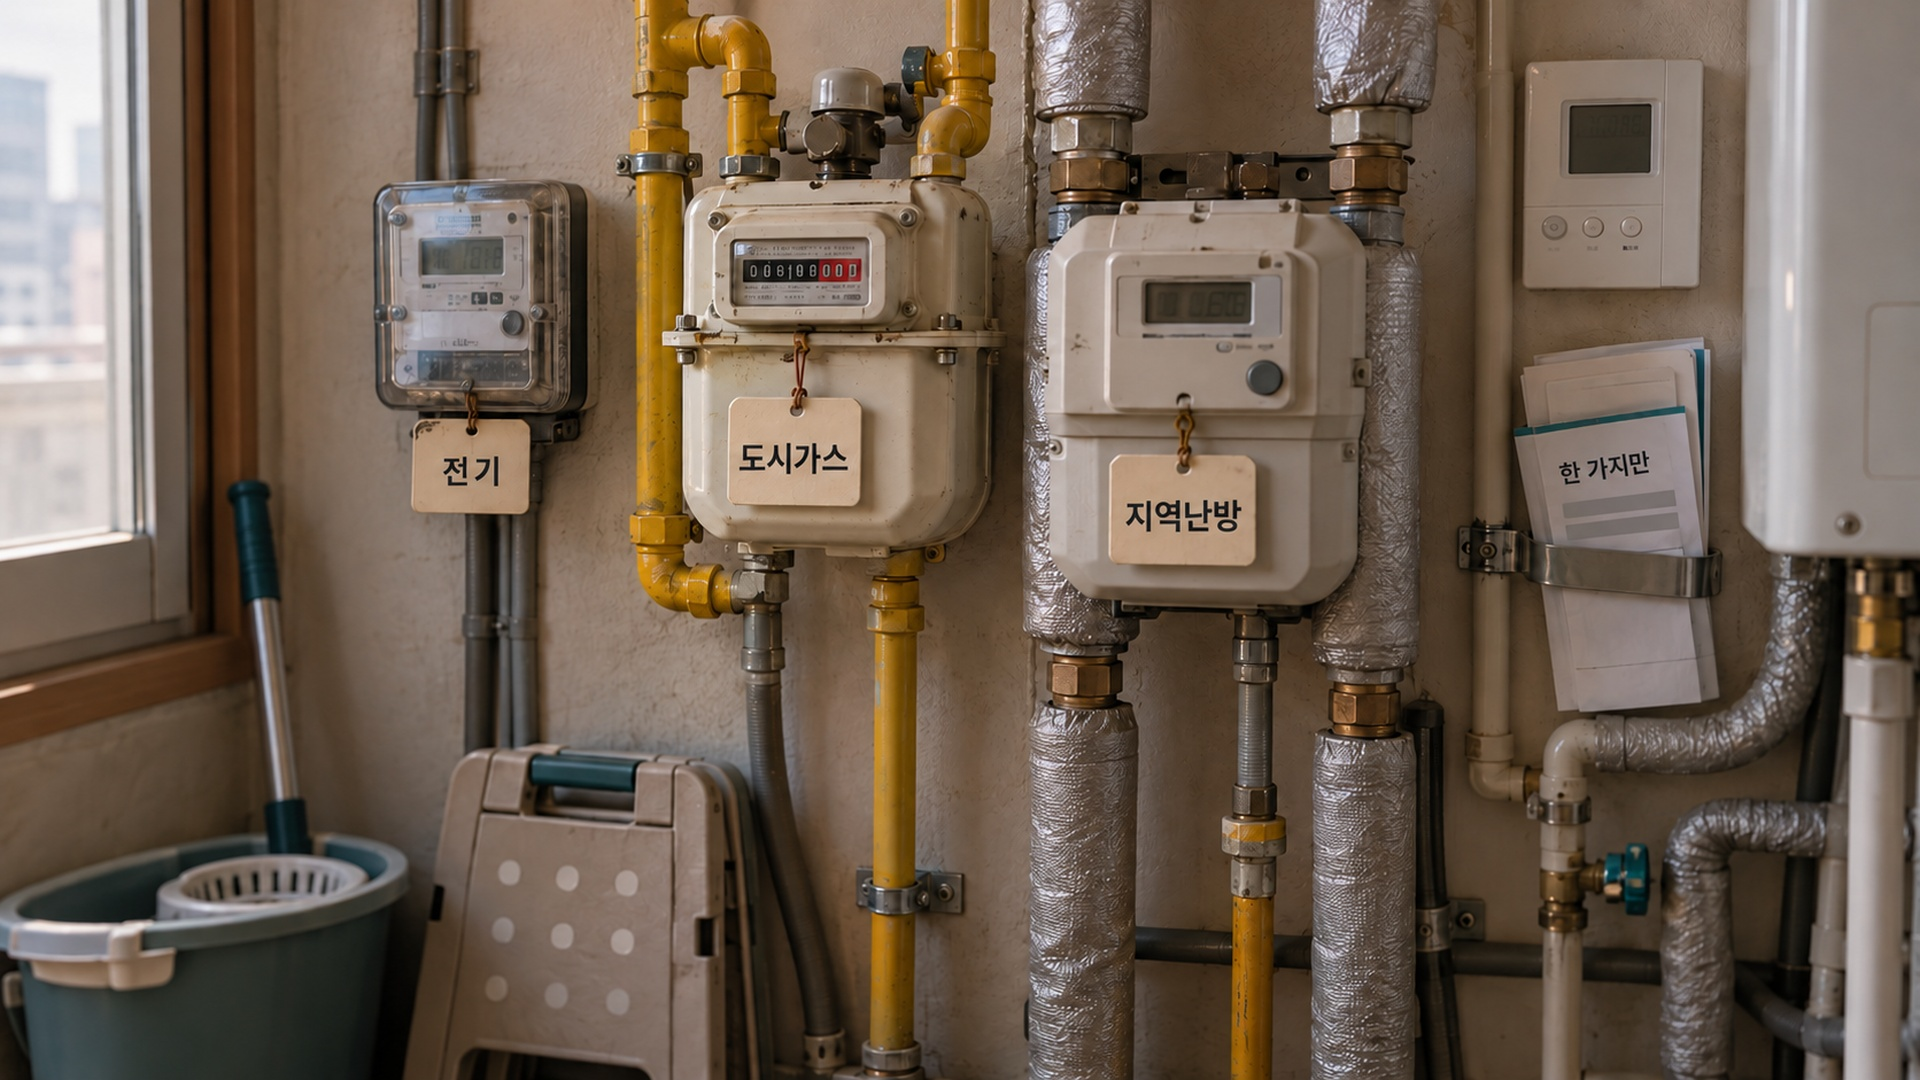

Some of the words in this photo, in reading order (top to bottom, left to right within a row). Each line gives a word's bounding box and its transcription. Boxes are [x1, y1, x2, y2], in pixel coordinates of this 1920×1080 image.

[442, 455, 499, 487] 전기
[738, 442, 849, 475] 도시가스
[1558, 460, 1581, 486] 한
[1586, 450, 1650, 481] 가지만
[1125, 499, 1242, 533] 지역난방
